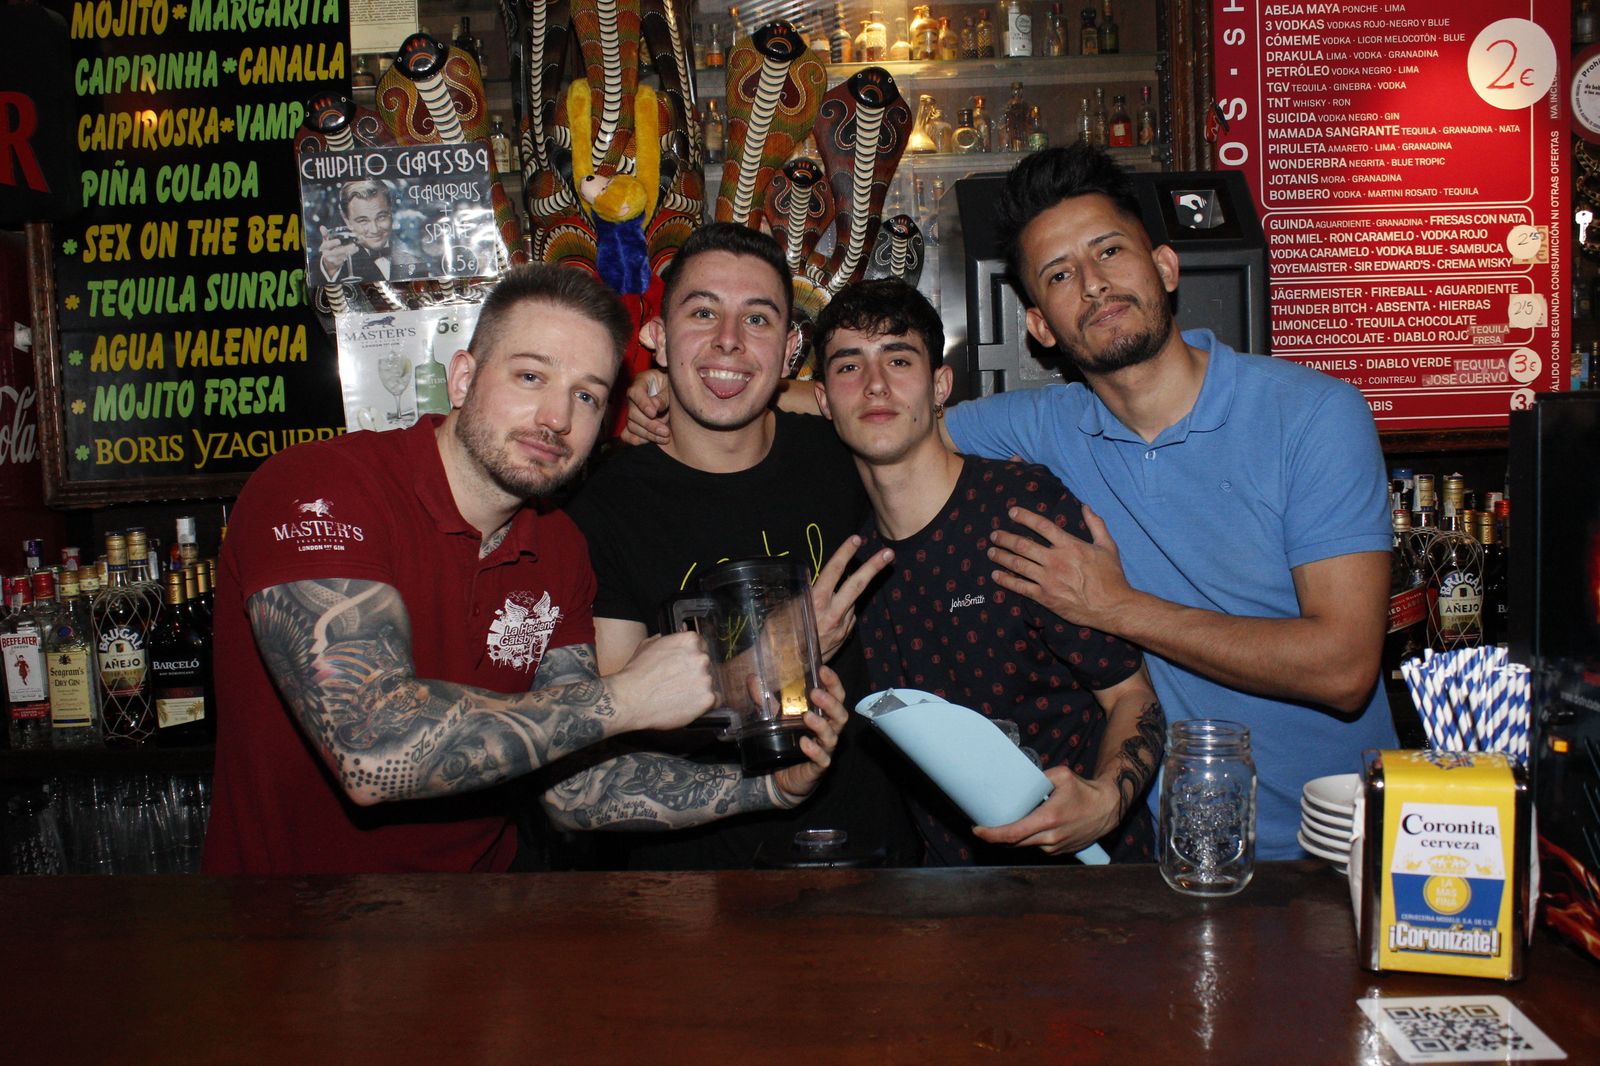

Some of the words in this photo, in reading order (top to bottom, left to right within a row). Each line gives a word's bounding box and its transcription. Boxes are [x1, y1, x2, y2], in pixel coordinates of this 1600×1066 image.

[1264, 4, 1304, 15] ABEJA
[1306, 3, 1340, 14] MAYA
[1342, 4, 1378, 13] PONCHE
[1384, 4, 1405, 12] LIMA
[71, 0, 168, 39] MOJITO
[188, 0, 340, 33] MARGARITA
[1274, 19, 1324, 30] VODKAS
[1326, 20, 1361, 29] VODKAS
[1427, 18, 1450, 26] BLUE
[1265, 33, 1320, 46] CÓMEME
[1321, 36, 1351, 44] VODKA
[1357, 35, 1382, 43] LICOR
[1384, 32, 1436, 43] MELOCOTÓN
[1443, 33, 1465, 41] BLUE
[1266, 50, 1323, 61] DRAKULA
[1326, 52, 1347, 60] LIMA
[1353, 51, 1381, 59] VODKA
[1388, 49, 1438, 58] GRANADINA
[75, 50, 219, 97] CAIPIRINHA
[238, 42, 345, 86] CANALLA
[1266, 63, 1329, 77] PETRÓLEO
[1331, 67, 1359, 75] VODKA
[1362, 66, 1391, 74] NEGRO
[1398, 65, 1419, 73] LIMA
[1486, 39, 1535, 89] 2€
[1266, 81, 1290, 92] TGV
[1291, 83, 1327, 91] TEQUILA
[1333, 82, 1372, 90] GINEBRA
[1377, 81, 1406, 89] VODKA
[1266, 97, 1290, 107] TNT
[1293, 98, 1325, 107] WHISKY
[1332, 98, 1350, 106] RON
[1267, 112, 1316, 123] SUICIDA
[1318, 113, 1346, 122] VODKA
[1348, 112, 1378, 121] NEGRO
[1384, 112, 1399, 120] GIN
[77, 107, 220, 152] CAIPIROSKA
[236, 101, 304, 142] VAMP
[1268, 127, 1322, 138] MAMADA
[1325, 124, 1399, 136] SANGRANTE
[1401, 126, 1436, 135] TEQUILA
[1442, 125, 1492, 134] GRANADINA
[1499, 124, 1520, 132] NATA
[1268, 142, 1326, 154] PIRULETA
[1328, 143, 1368, 152] AMARETO
[1375, 143, 1395, 151] LIMA
[1402, 141, 1451, 150] GRANADINA
[1550, 130, 1560, 175] OFERTAS
[301, 153, 388, 180] CHUPITO
[396, 148, 489, 177] GATSBY
[1268, 157, 1346, 169] WONDERBRA
[1349, 158, 1384, 167] NEGRITA
[1391, 158, 1412, 166] BLUE
[1414, 157, 1445, 165] TROPIC
[81, 160, 147, 208] PIÑA
[156, 160, 259, 204] COLADA
[1268, 173, 1318, 184] JOTANIS
[1321, 175, 1345, 183] MORA
[1352, 173, 1401, 182] GRANADINA
[408, 181, 481, 205] TAURUS
[1269, 188, 1330, 200] BOMBERO
[1332, 190, 1361, 198] VODKA
[1368, 189, 1402, 197] MARTINI
[1405, 188, 1437, 196] ROSATO
[1444, 187, 1478, 195] TEQUILA
[1551, 175, 1560, 208] OTRAS
[1269, 218, 1314, 229] GUINDA
[1315, 219, 1370, 228] AGUARDIENTE
[1375, 218, 1423, 226] GRANADINA
[1430, 214, 1472, 225] FRESAS
[1473, 213, 1496, 224] CON
[1499, 213, 1526, 223] NATA
[1551, 209, 1560, 220] NI
[83, 223, 132, 264] SEX
[140, 220, 179, 260] ON
[187, 217, 239, 257] THE
[247, 213, 306, 254] BEA
[1270, 234, 1293, 244] RON
[1295, 233, 1323, 243] MIEL
[1329, 232, 1353, 242] RON
[1354, 230, 1414, 241] CARAMELO
[1420, 229, 1458, 240] VODKA
[1459, 228, 1488, 239] ROJO
[1270, 248, 1308, 258] VODKA
[1309, 246, 1369, 257] CARAMELO
[1375, 245, 1413, 256] VODKA
[1414, 244, 1443, 254] BLUE
[1449, 243, 1504, 254] SAMBUCA
[1549, 221, 1560, 290] CONSUMICIÓN
[1270, 261, 1347, 273] YOYEMAISTER
[1353, 261, 1372, 271] SIR
[1373, 259, 1430, 270] EDWARD'S
[1436, 258, 1476, 269] CREMA
[1477, 257, 1512, 267] WISKY
[87, 275, 197, 320] TEQUILA
[204, 268, 308, 312] SUNRIS
[1271, 287, 1362, 300] JÄGERMEISTER
[1371, 285, 1427, 296] FIREBALL
[1434, 283, 1518, 295] AGUARDIENTE
[1271, 303, 1329, 315] THUNDER
[1332, 302, 1366, 313] BITCH
[1375, 300, 1430, 312] ABSENTA
[1438, 299, 1490, 310] HIERBAS
[1551, 292, 1560, 338] SEGUNDA
[1272, 318, 1347, 330] LIMONCELLO
[1355, 316, 1405, 328] TEQUILA
[1407, 314, 1476, 326] CHOCOLATE
[1470, 325, 1510, 334] TEQUILA
[345, 327, 417, 342] MASTER'S
[1271, 334, 1313, 345] VODKA
[1314, 332, 1384, 344] CHOCOLATE
[1393, 331, 1436, 342] DIABLO
[1438, 329, 1470, 340] ROJO
[1473, 335, 1502, 344] FRESA
[90, 332, 164, 373] AGUA
[174, 324, 307, 369] VALENCIA
[1551, 344, 1560, 360] CON
[1366, 358, 1409, 368] DIABLO
[1411, 356, 1451, 367] VERDE
[1454, 359, 1506, 371] TEQUILA
[1514, 354, 1537, 374] 3€
[1368, 375, 1416, 384] COINTREAU
[1428, 374, 1457, 385] JOSE
[1459, 371, 1508, 384] CUERVO
[93, 379, 195, 422] MOJITO
[203, 375, 286, 419] FRESA
[95, 435, 185, 465] BORIS
[272, 520, 364, 542] MASTER'S
[1440, 571, 1483, 596] BRUGAL
[1445, 602, 1480, 613] AÑEJO
[504, 626, 518, 636] La
[2, 636, 38, 648] BEEFEATER
[98, 627, 144, 652] BRUGAL
[104, 658, 141, 669] AÑEJO
[152, 658, 200, 671] BARCELÓ
[50, 667, 85, 678] Seagram's
[1401, 812, 1496, 836] Coronita
[1420, 838, 1480, 850] cerveza
